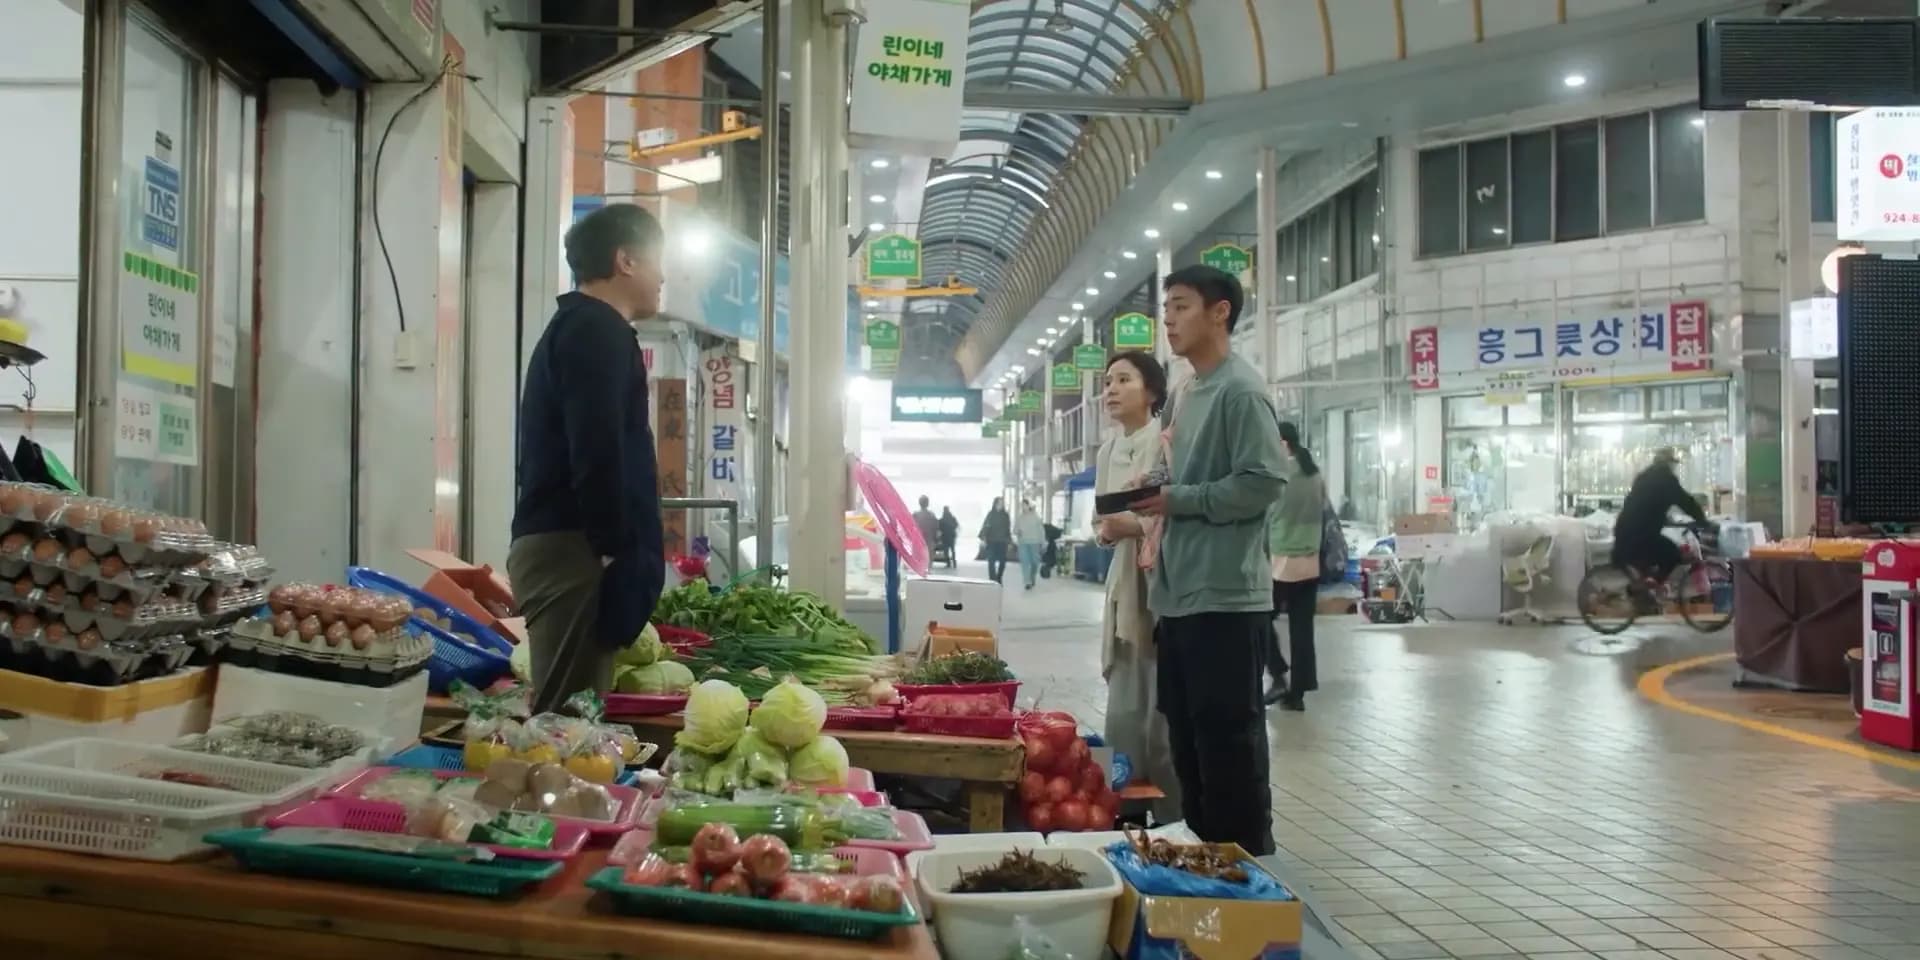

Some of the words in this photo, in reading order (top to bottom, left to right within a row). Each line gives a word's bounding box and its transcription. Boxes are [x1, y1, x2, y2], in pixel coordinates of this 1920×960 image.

[883, 35, 944, 60] 린이네
[868, 62, 952, 88] 야채가게
[147, 292, 176, 321] 린이네
[143, 324, 181, 352] 야채가게
[1674, 305, 1703, 367] 잡화
[1414, 332, 1436, 386] 주방
[706, 356, 734, 409] 양념
